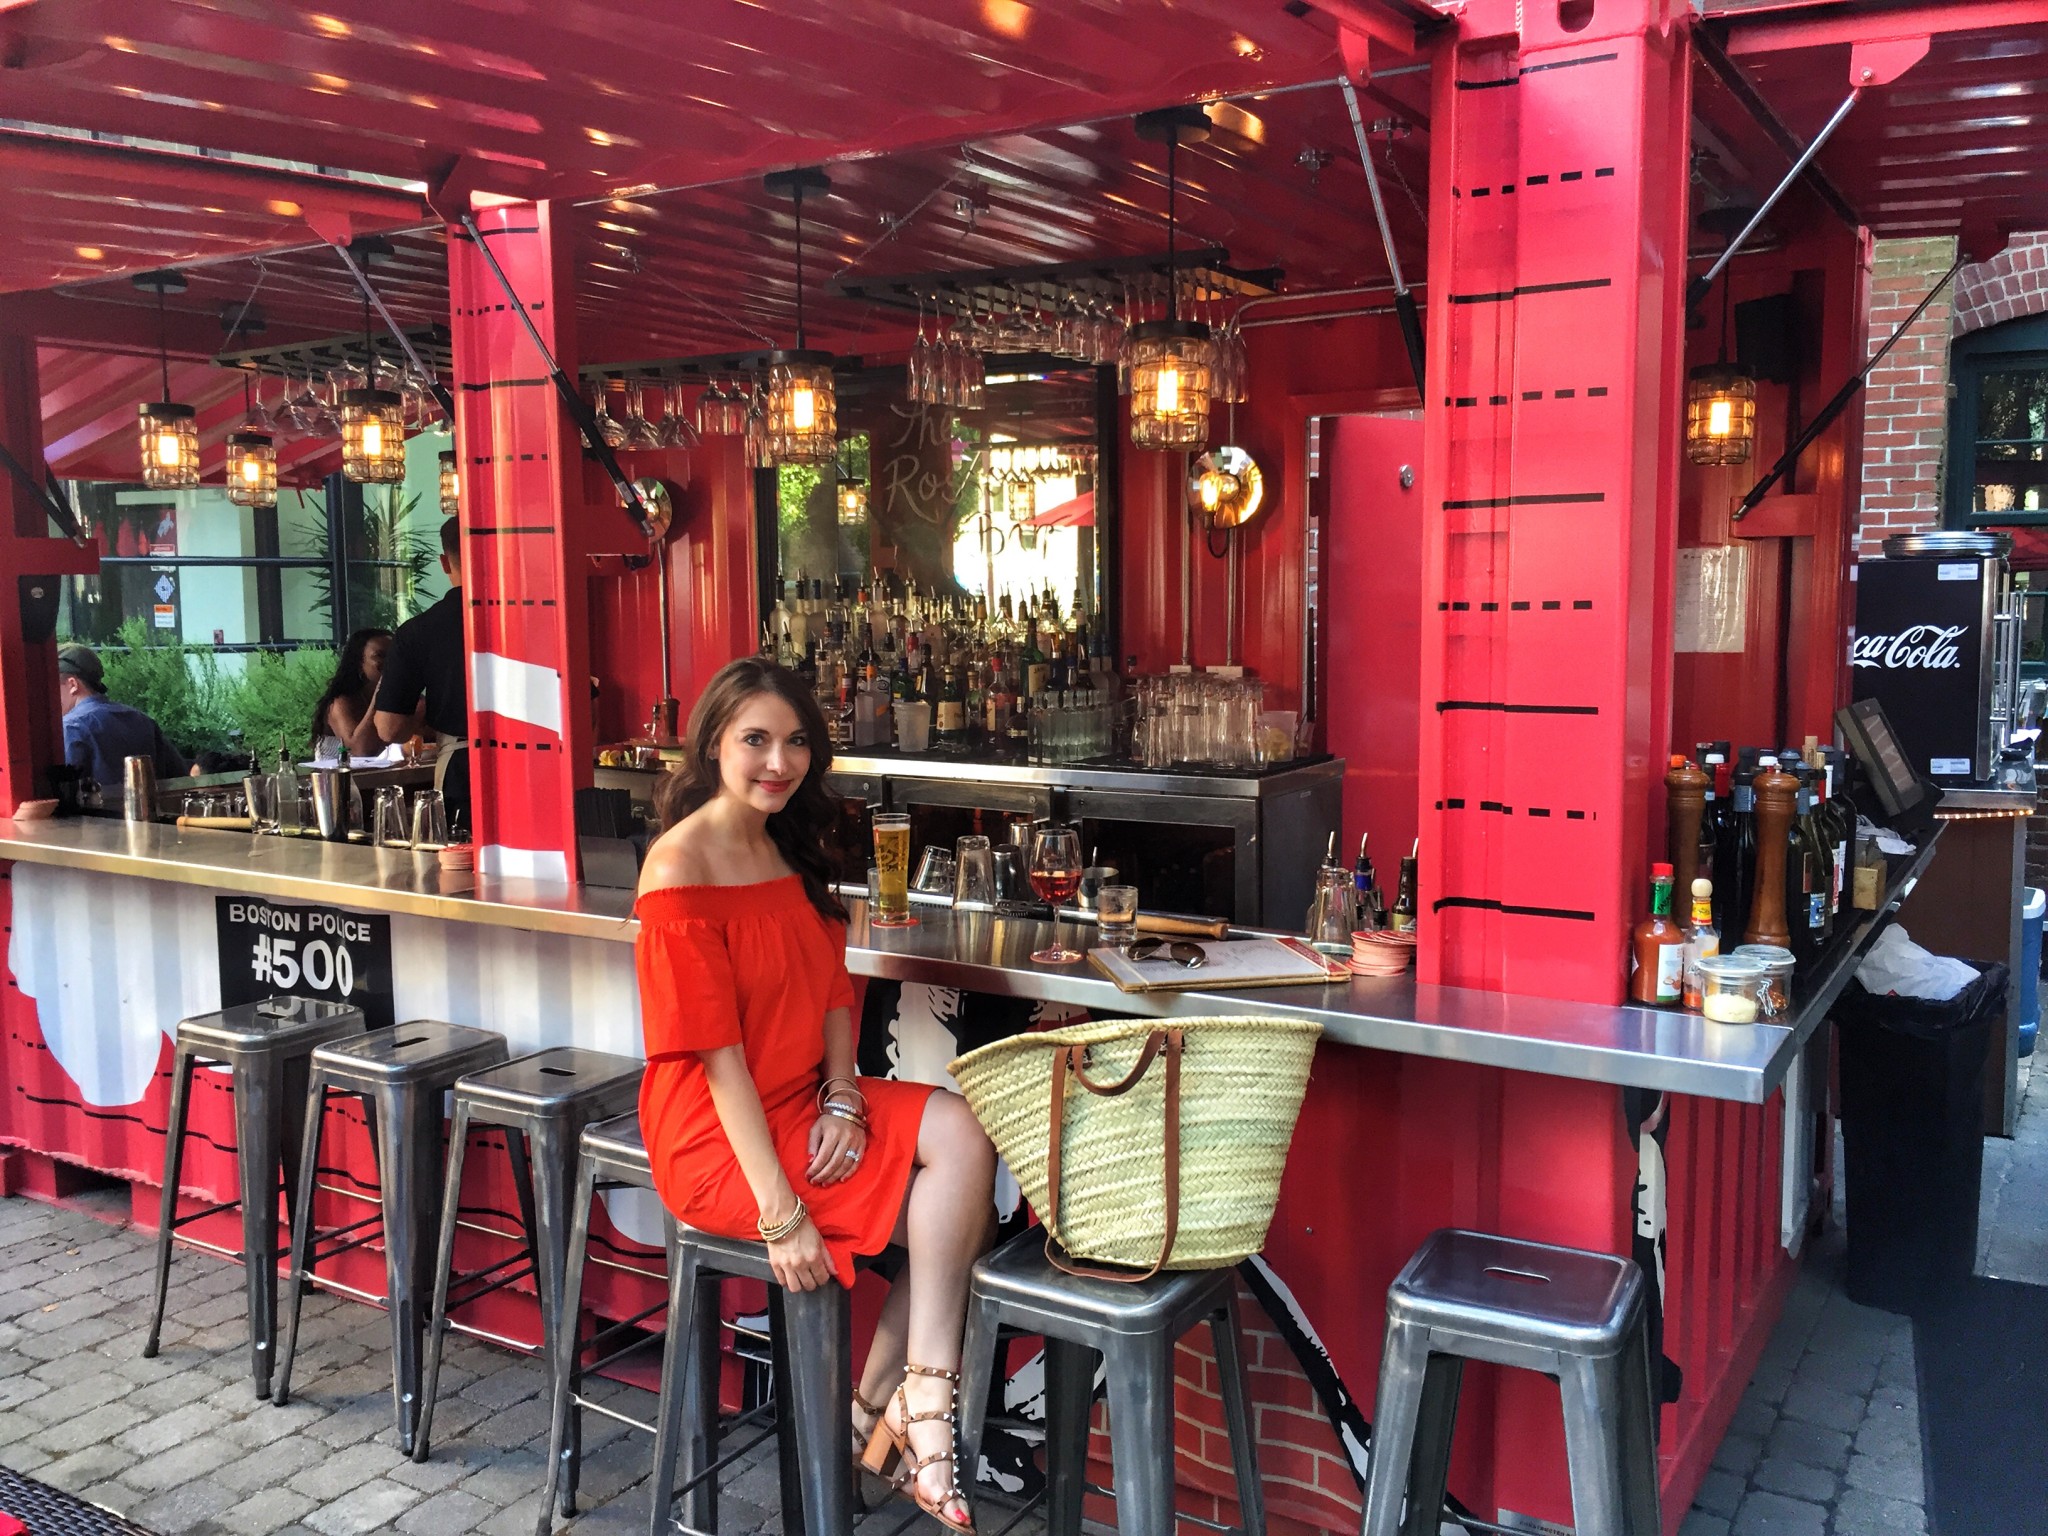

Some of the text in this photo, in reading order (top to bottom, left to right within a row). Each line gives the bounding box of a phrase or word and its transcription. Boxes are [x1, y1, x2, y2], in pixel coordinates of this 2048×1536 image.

[229, 904, 370, 942] BOSTON POLICE
[251, 933, 353, 997] #500
